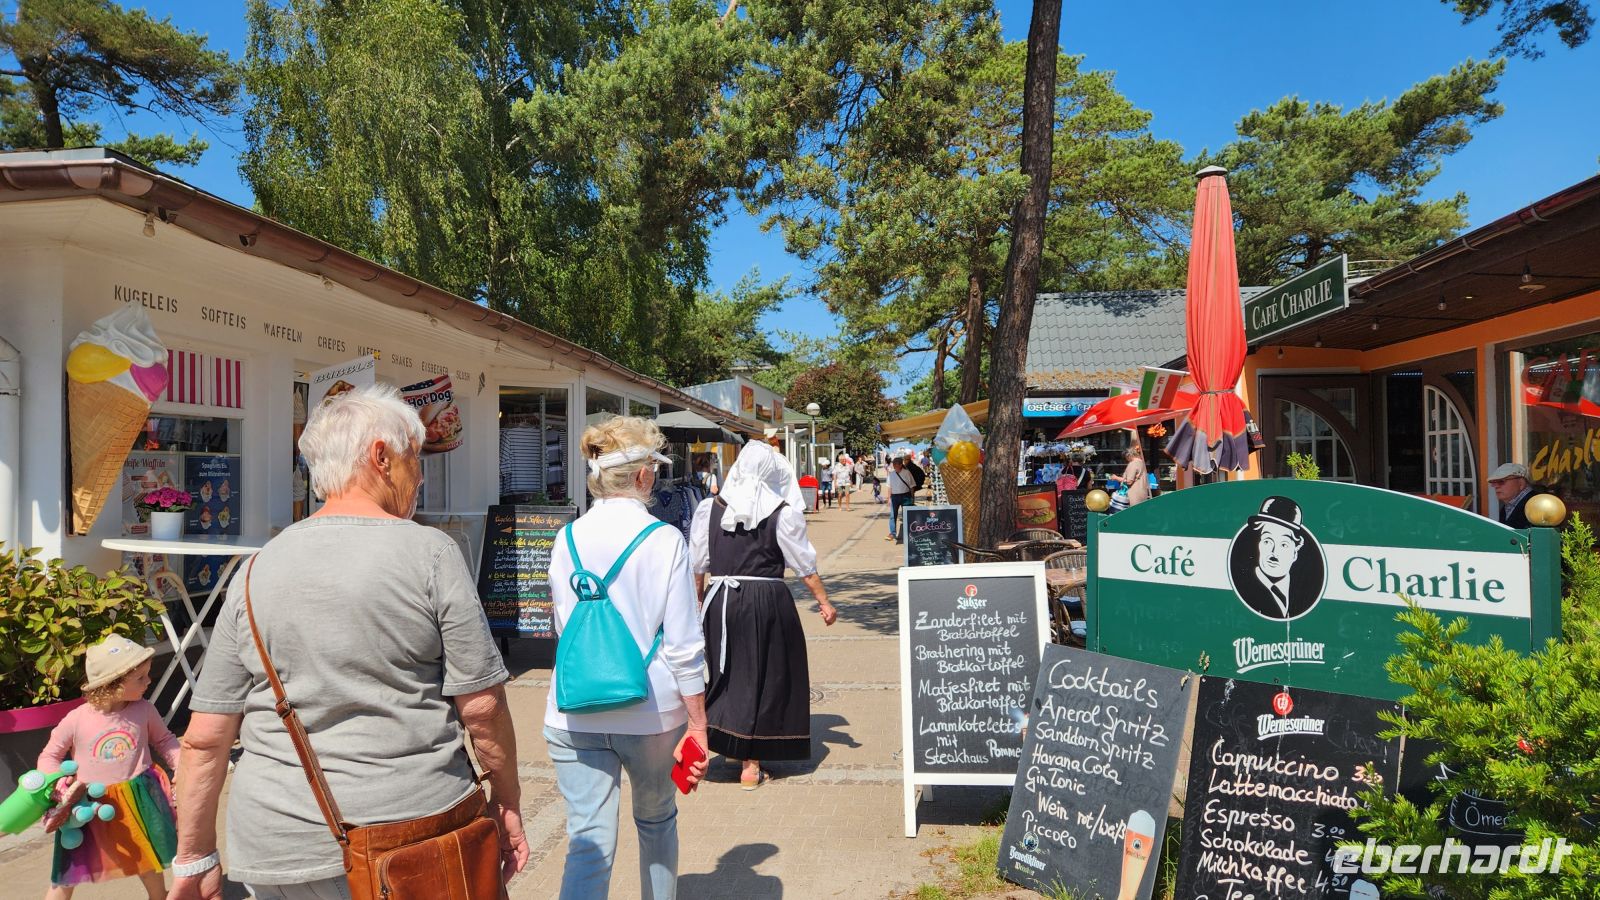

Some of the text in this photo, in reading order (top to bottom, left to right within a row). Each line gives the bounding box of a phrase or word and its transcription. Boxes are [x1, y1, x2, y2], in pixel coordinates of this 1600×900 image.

[114, 284, 178, 313] KUGELEIS
[201, 306, 247, 330] SOFTEIS
[264, 322, 303, 343] WAFFELN
[317, 335, 346, 352] CREPES
[1252, 278, 1333, 330] CAFÉ CHARLIE
[408, 390, 453, 409] Hot Dog
[1026, 401, 1071, 413] ostsee
[1130, 543, 1506, 604] Café Charlie
[915, 611, 1028, 632] Zanderfilet mit
[939, 625, 1020, 642] Bratkartoffel
[915, 641, 1012, 663] Brathering mit
[938, 655, 1025, 675] Bratkartoffel
[1233, 637, 1325, 666] Wernesgrüner
[918, 675, 1032, 700] Matjesfilet mit
[1049, 660, 1158, 709] Cocktails
[938, 694, 1027, 715] Bratkartoffel
[1039, 695, 1169, 748] Aperol Spritz
[1257, 715, 1326, 738] Wernesgrüner
[924, 739, 1022, 765] Steakhaus Pomme
[937, 735, 959, 749] mit
[1035, 721, 1155, 770] Sanddorn Spritz
[1082, 757, 1122, 786] Cola
[1212, 739, 1340, 781] Cappuccino
[1047, 768, 1086, 796] Tonic
[1208, 769, 1358, 810] Lattemacchiato
[1038, 792, 1069, 820] Wein
[1203, 799, 1296, 833] Espresso
[1022, 811, 1077, 849] Piccolo
[1200, 829, 1313, 866] Schokolade
[1196, 850, 1308, 896] Milchkaffee
